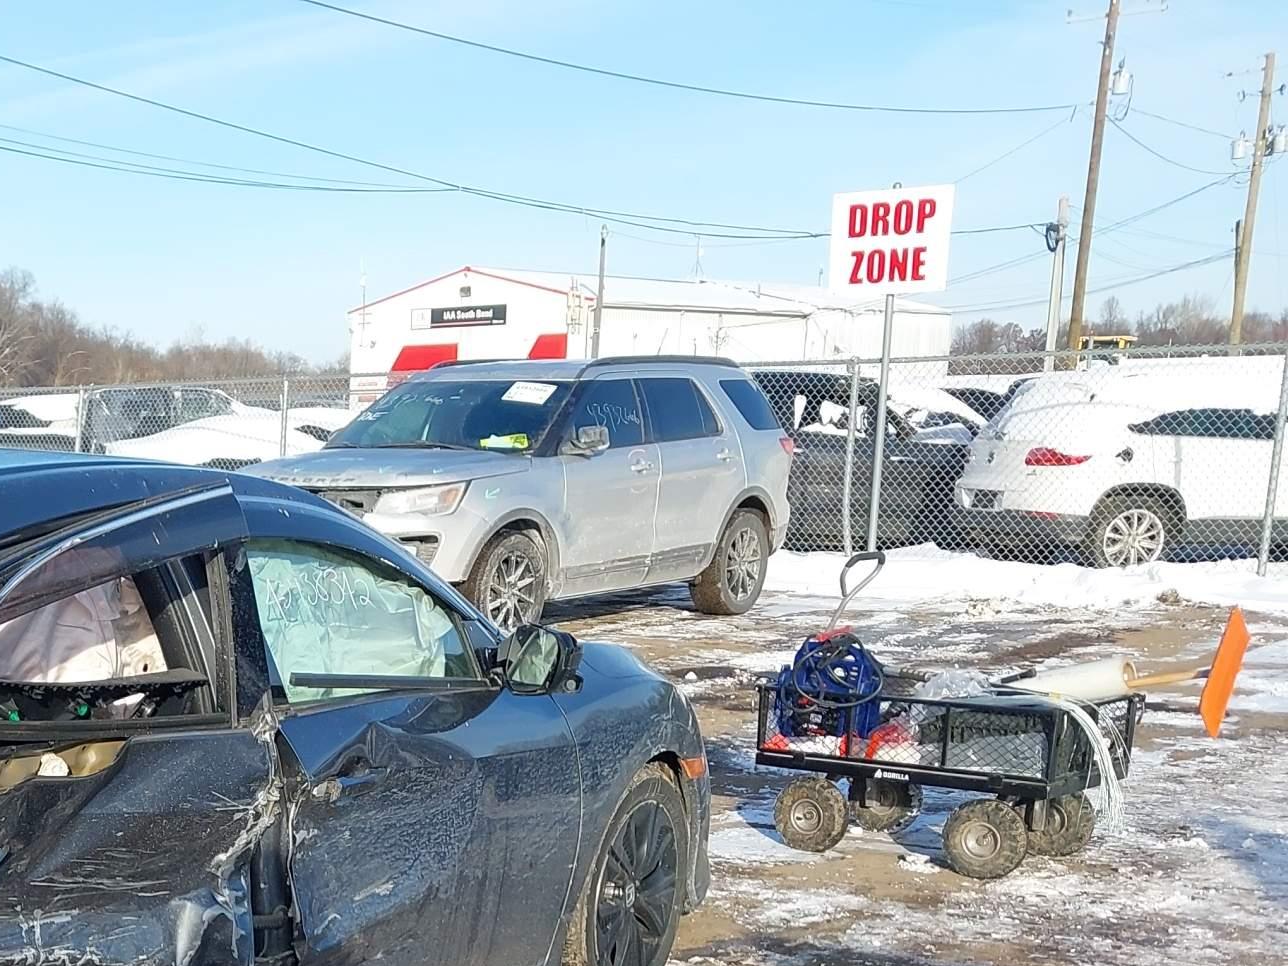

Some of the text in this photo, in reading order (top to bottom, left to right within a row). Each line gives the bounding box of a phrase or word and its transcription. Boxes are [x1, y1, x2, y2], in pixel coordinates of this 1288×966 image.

[848, 198, 936, 238] DROP
[848, 246, 927, 284] ZONE
[443, 311, 456, 320] IAA
[457, 309, 475, 319] South
[883, 771, 909, 780] GORILLA
